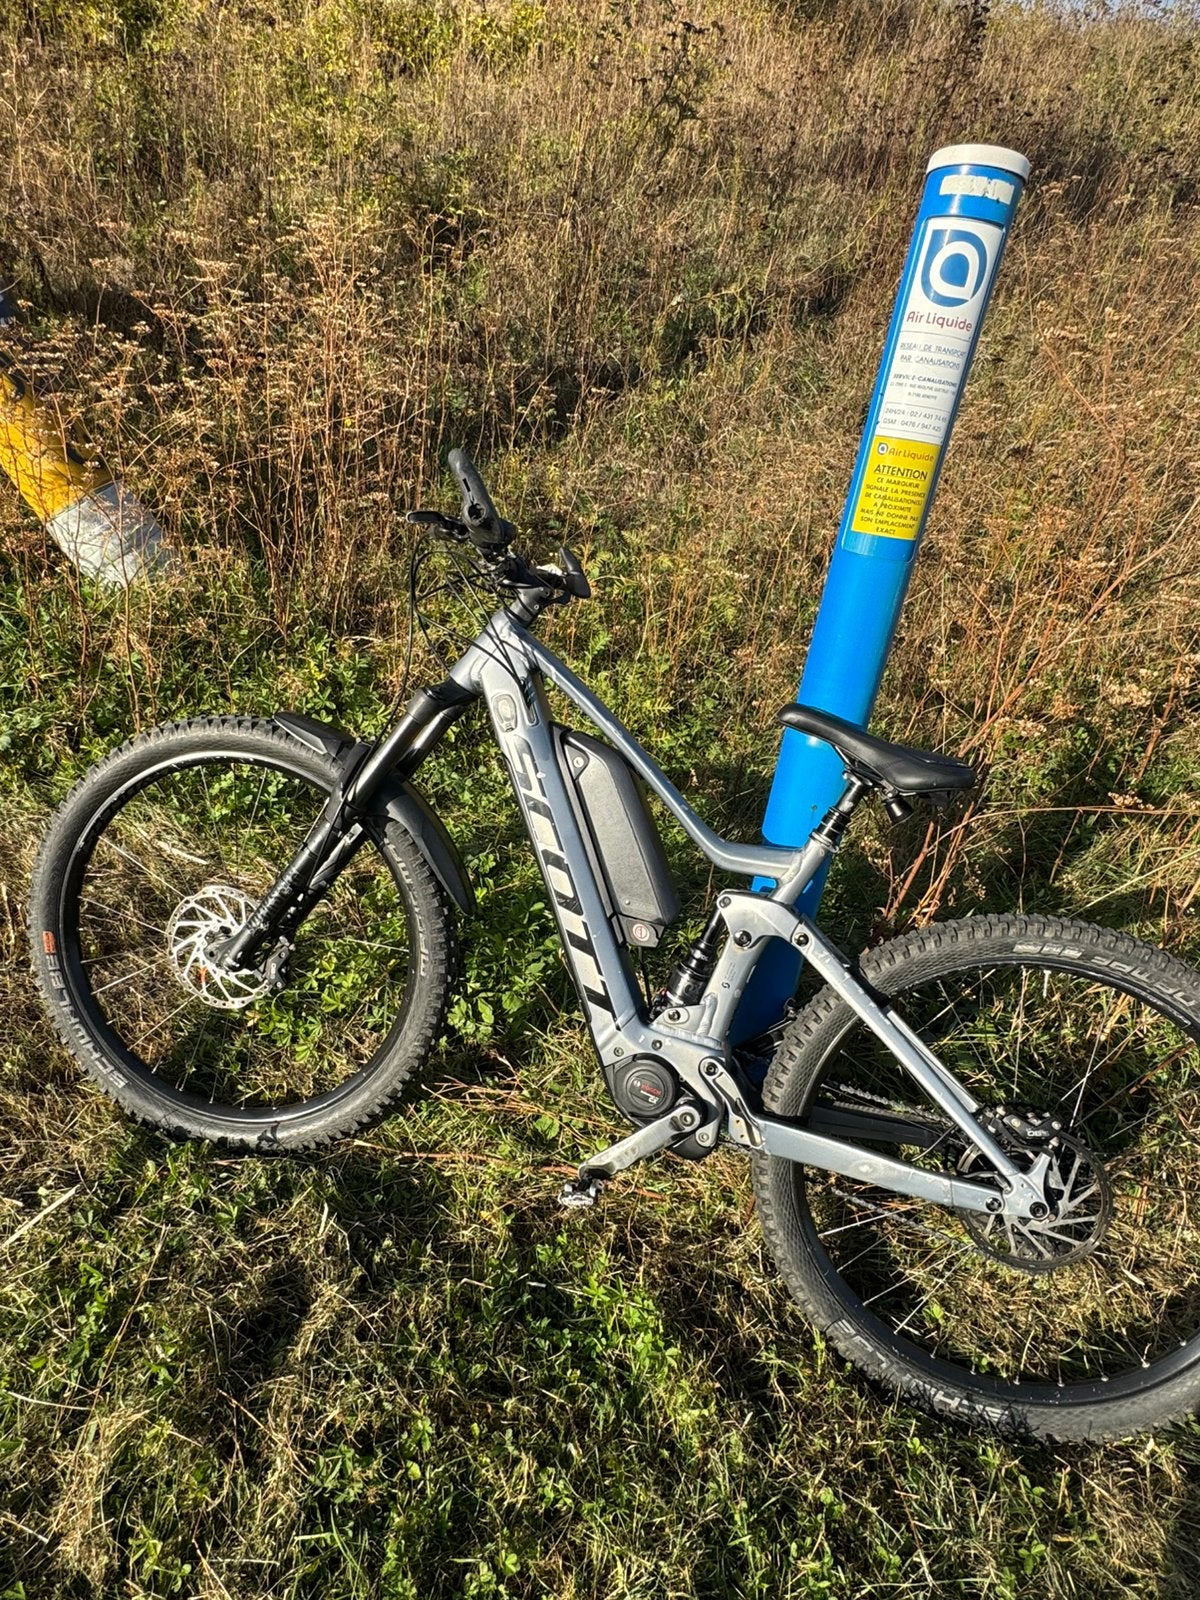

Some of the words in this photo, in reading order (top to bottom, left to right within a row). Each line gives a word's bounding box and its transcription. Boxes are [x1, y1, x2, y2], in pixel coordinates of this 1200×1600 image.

[906, 311, 924, 323] Air
[925, 312, 973, 332] Liquide
[888, 447, 902, 457] Air
[902, 449, 934, 462] Liquide
[874, 464, 928, 480] ATTENTION
[45, 953, 130, 1090] SCHWALBE
